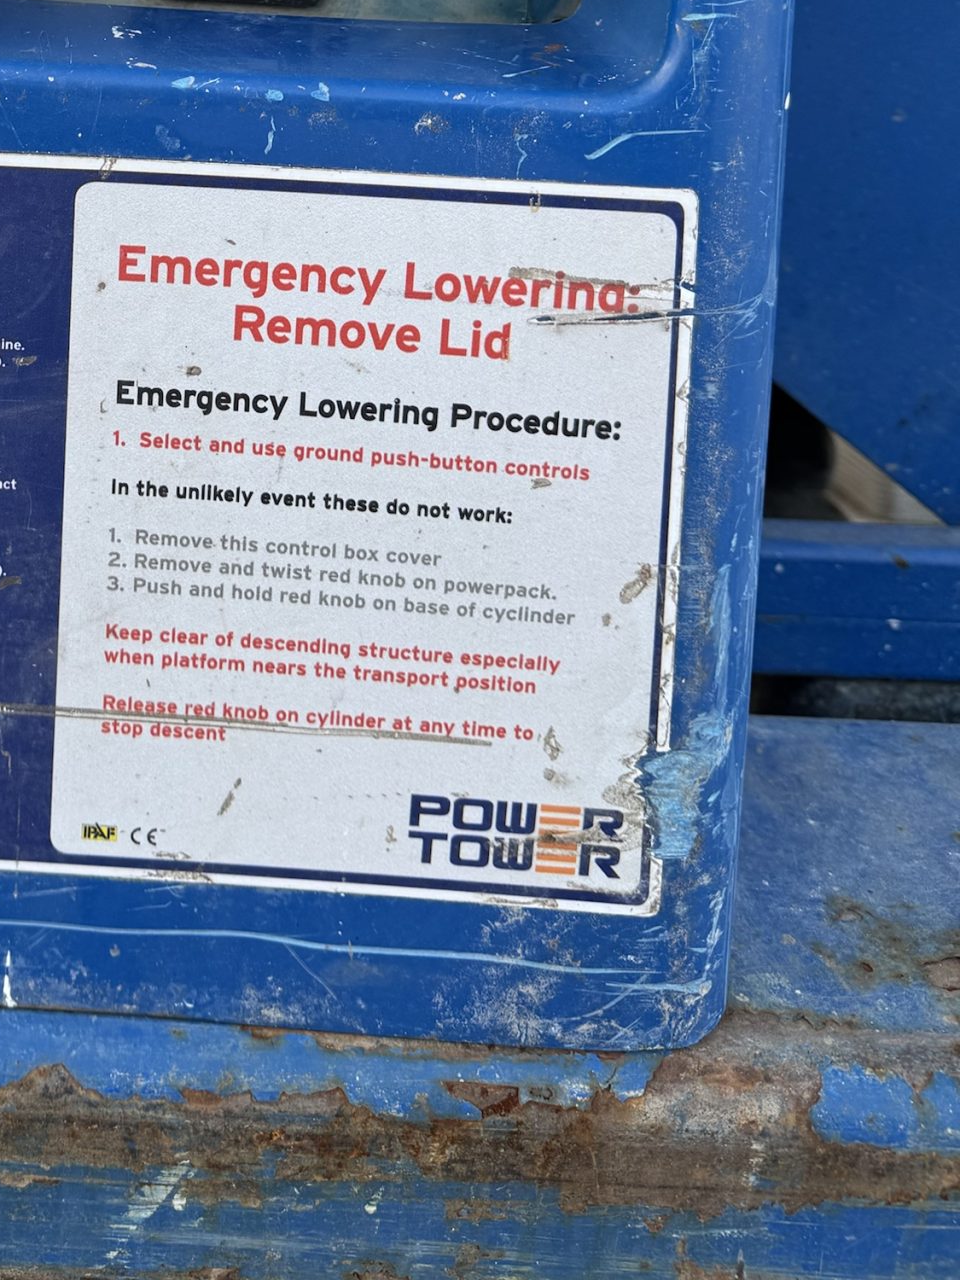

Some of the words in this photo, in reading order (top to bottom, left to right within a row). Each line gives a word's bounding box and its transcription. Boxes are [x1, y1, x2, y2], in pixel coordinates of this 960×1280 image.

[118, 244, 387, 306] Emergency
[233, 304, 421, 353] Remove
[439, 318, 512, 360] Lid
[116, 380, 289, 421] Emergency
[299, 392, 439, 432] Lowering
[450, 403, 622, 441] Procedure:
[112, 430, 126, 447] 1.
[139, 432, 202, 451] Select
[209, 438, 245, 454] and
[252, 442, 287, 459] use
[293, 446, 364, 463] ground
[370, 451, 498, 474] push-button
[504, 461, 590, 481] controls
[111, 478, 129, 496] In
[136, 480, 169, 498] the
[176, 484, 254, 507] unlikely
[260, 491, 316, 509] event
[322, 493, 379, 513] these
[386, 498, 410, 516] do
[417, 503, 451, 519] not
[457, 506, 513, 524] work:
[108, 527, 122, 544] 1.
[135, 529, 213, 549] Remove
[219, 534, 258, 553] this
[265, 540, 337, 558] control
[344, 544, 379, 562] box
[386, 551, 442, 566] cover
[107, 551, 127, 568] 2.
[134, 553, 212, 573] Remove
[218, 561, 255, 576] and
[261, 562, 312, 581] twist
[319, 568, 351, 583] red
[358, 569, 406, 588] knob
[412, 577, 437, 591] on
[443, 579, 557, 600] powerpack.
[106, 576, 125, 592] 3.
[133, 577, 182, 596] Push
[189, 583, 225, 599] and
[231, 584, 273, 602] hold
[279, 590, 312, 605] red
[318, 591, 366, 609] knob
[372, 598, 396, 612] on
[403, 598, 450, 615] base
[456, 602, 477, 617] of
[482, 606, 576, 625] cyclinder
[104, 648, 154, 666] when
[161, 652, 245, 672] platform
[252, 660, 307, 677] nears
[313, 662, 347, 679] the
[353, 664, 449, 688] transport
[453, 675, 536, 694] position
[105, 623, 153, 644] Keep
[159, 627, 209, 645] clear
[214, 631, 234, 647] of
[240, 633, 351, 659] descending
[358, 642, 454, 664] structure
[460, 653, 561, 676] especially
[408, 793, 625, 843] POWER
[408, 830, 621, 879] TOWER
